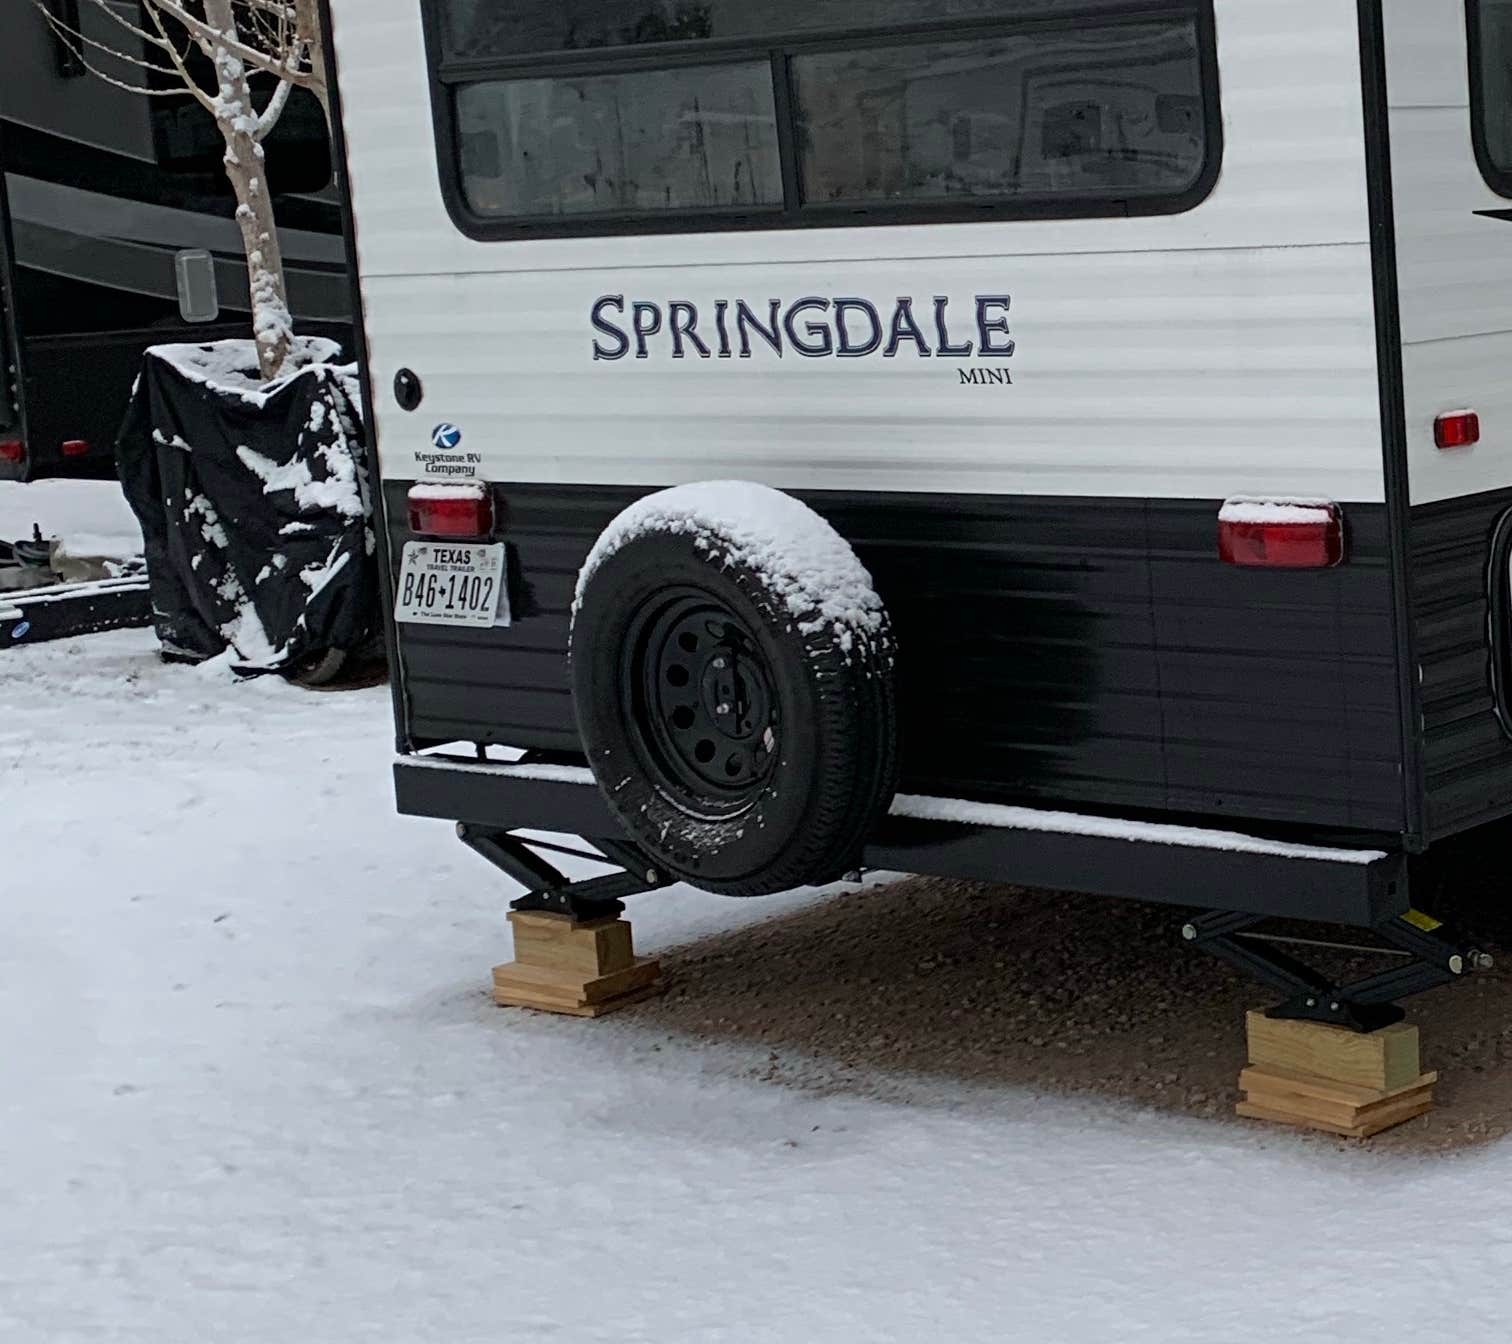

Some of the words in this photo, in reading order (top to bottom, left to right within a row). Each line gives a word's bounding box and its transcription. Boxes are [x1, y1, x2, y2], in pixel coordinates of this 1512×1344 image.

[591, 294, 1015, 361] SPRINGDALE
[957, 368, 1013, 385] MINI
[414, 451, 465, 464] Keystone
[467, 453, 481, 463] RV
[425, 463, 475, 477] Company
[433, 548, 471, 564] TEXAS
